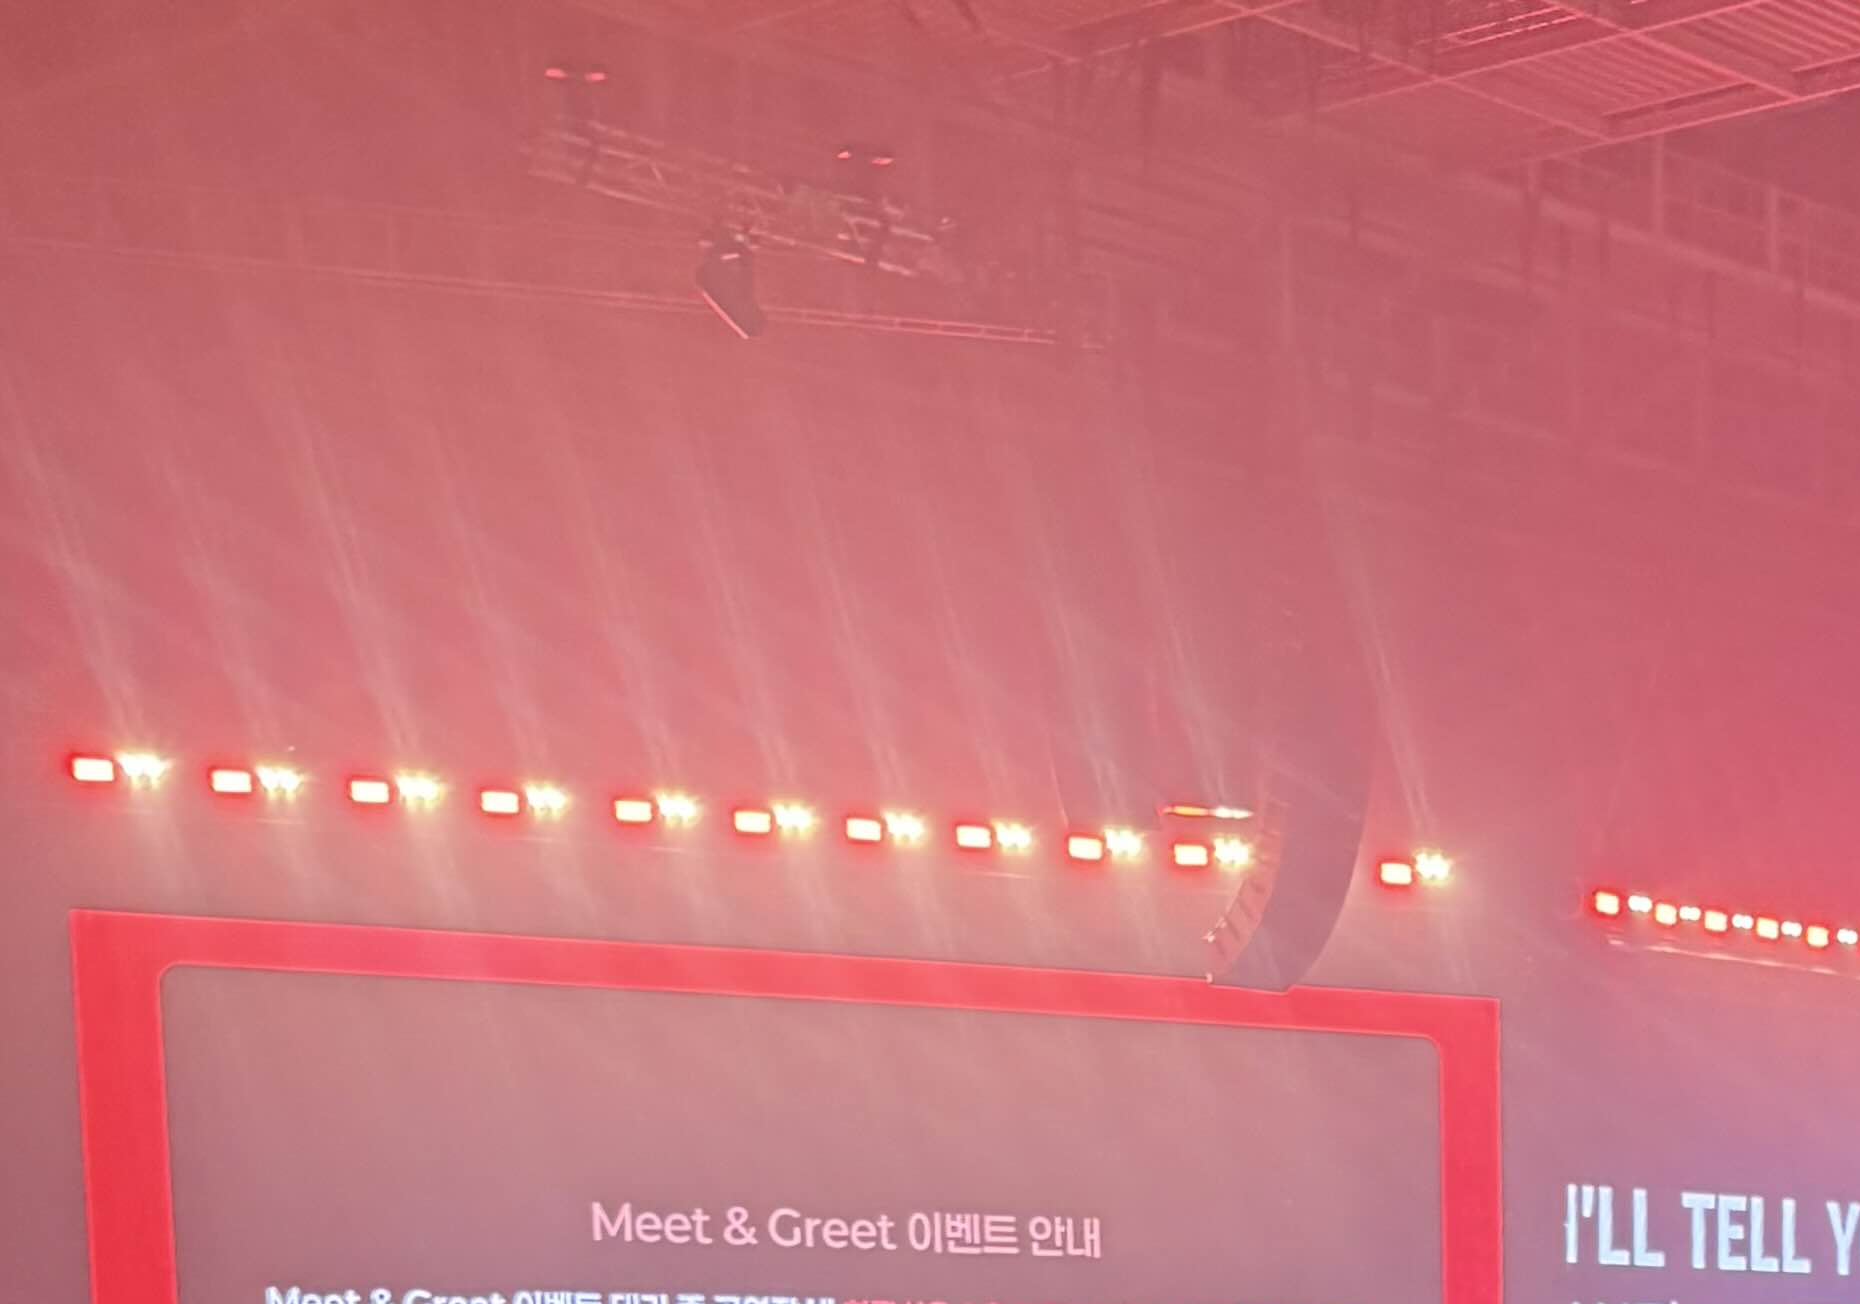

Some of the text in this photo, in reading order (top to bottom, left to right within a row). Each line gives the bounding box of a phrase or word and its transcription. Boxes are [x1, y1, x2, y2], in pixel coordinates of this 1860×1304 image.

[590, 1202, 1101, 1259] Meet & Greet 이벤트 안내
[1565, 1185, 1663, 1267] I'LL
[1682, 1193, 1811, 1272] TELL
